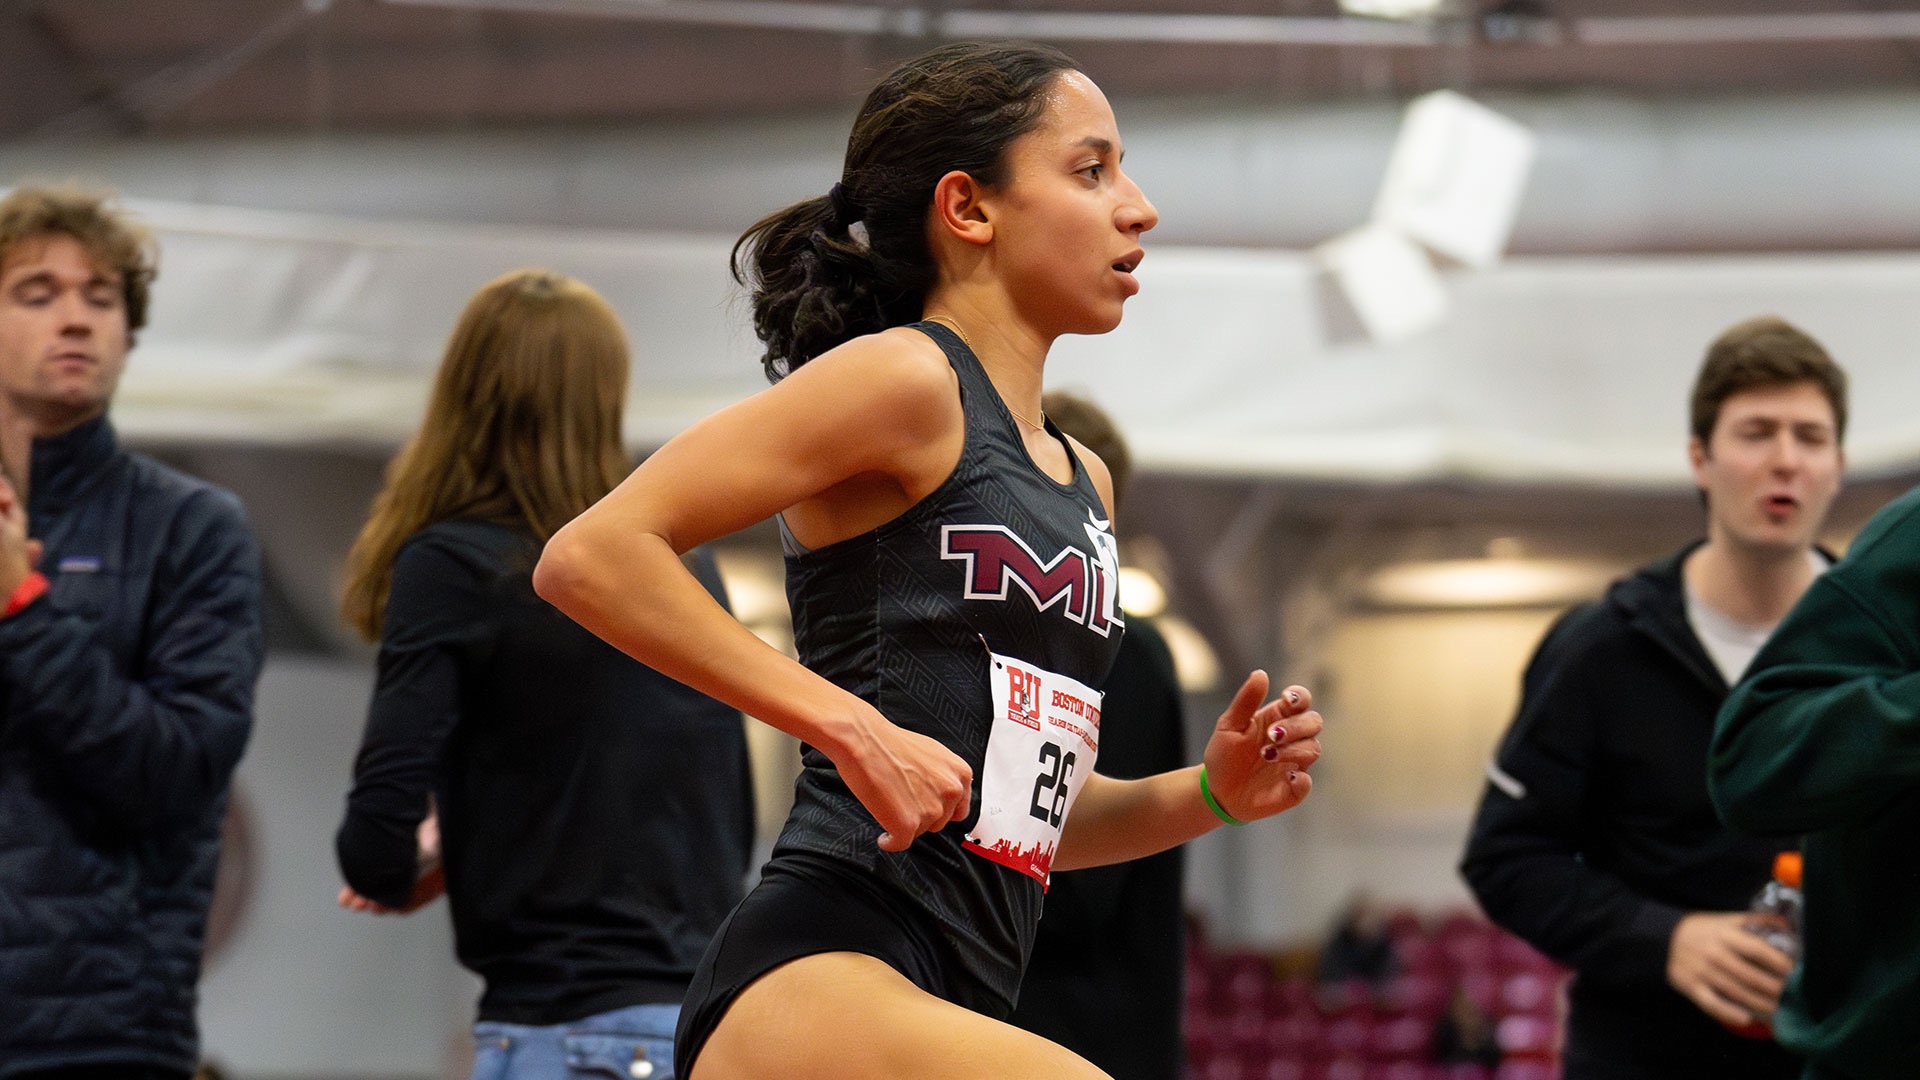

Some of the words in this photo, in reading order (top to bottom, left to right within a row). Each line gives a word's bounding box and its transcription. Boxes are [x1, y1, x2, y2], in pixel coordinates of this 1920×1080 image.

[1006, 665, 1041, 720] BU
[1052, 690, 1085, 717] BOSTON
[1030, 741, 1077, 833] 26
